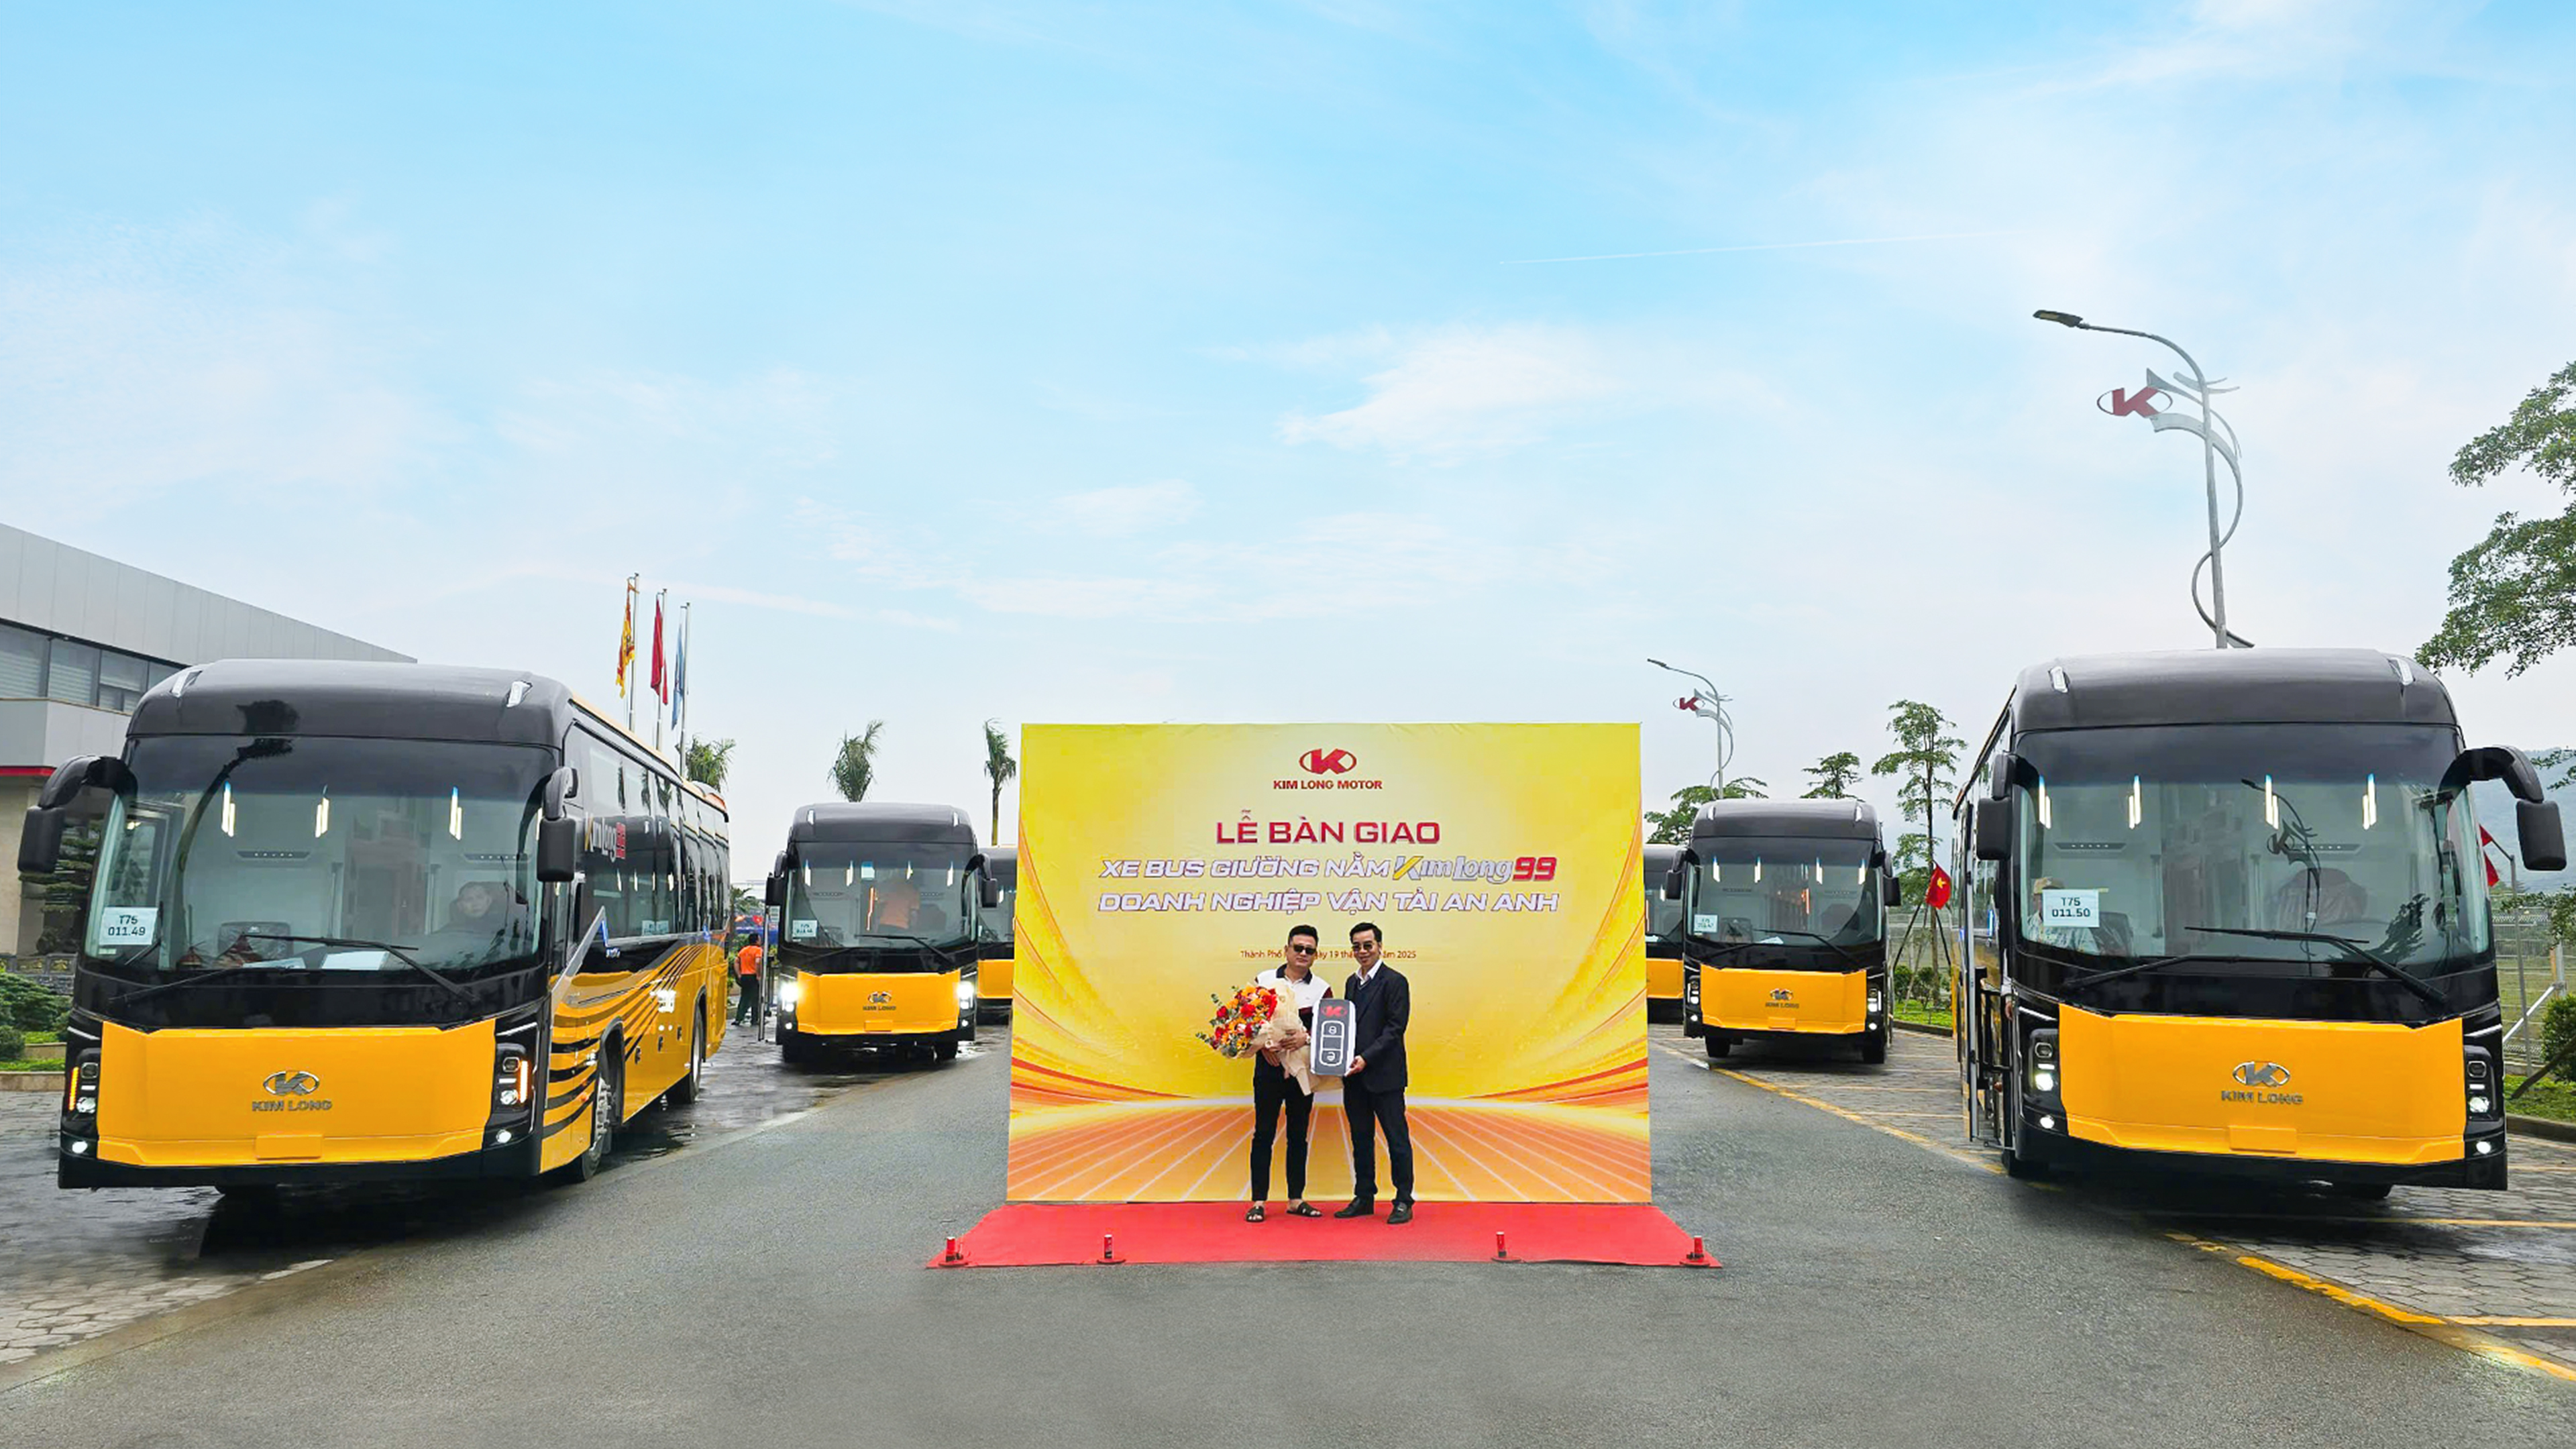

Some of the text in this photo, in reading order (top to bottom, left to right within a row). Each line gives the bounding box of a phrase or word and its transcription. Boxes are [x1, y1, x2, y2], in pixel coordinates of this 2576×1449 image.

[1273, 780, 1383, 790] KIM LONG MOTOR
[1216, 809, 1440, 844] LỄ BÀN GIAO
[1099, 859, 1141, 877] XE
[1144, 859, 1205, 877] BUS
[1210, 855, 1320, 877] GIƯỜNG
[1324, 852, 1391, 877] NẰM
[1098, 887, 1560, 915] DOANH NGHIỆP VẬN TẢI AN ANH
[2061, 897, 2081, 906] T75
[2051, 908, 2091, 917] 011.50
[119, 915, 138, 924] T75
[108, 926, 146, 936] 011.49
[1330, 951, 1339, 959] 19
[1397, 950, 1417, 959] 2025
[2221, 1091, 2303, 1105] KIM LONG
[252, 1100, 333, 1111] KIM LONG
